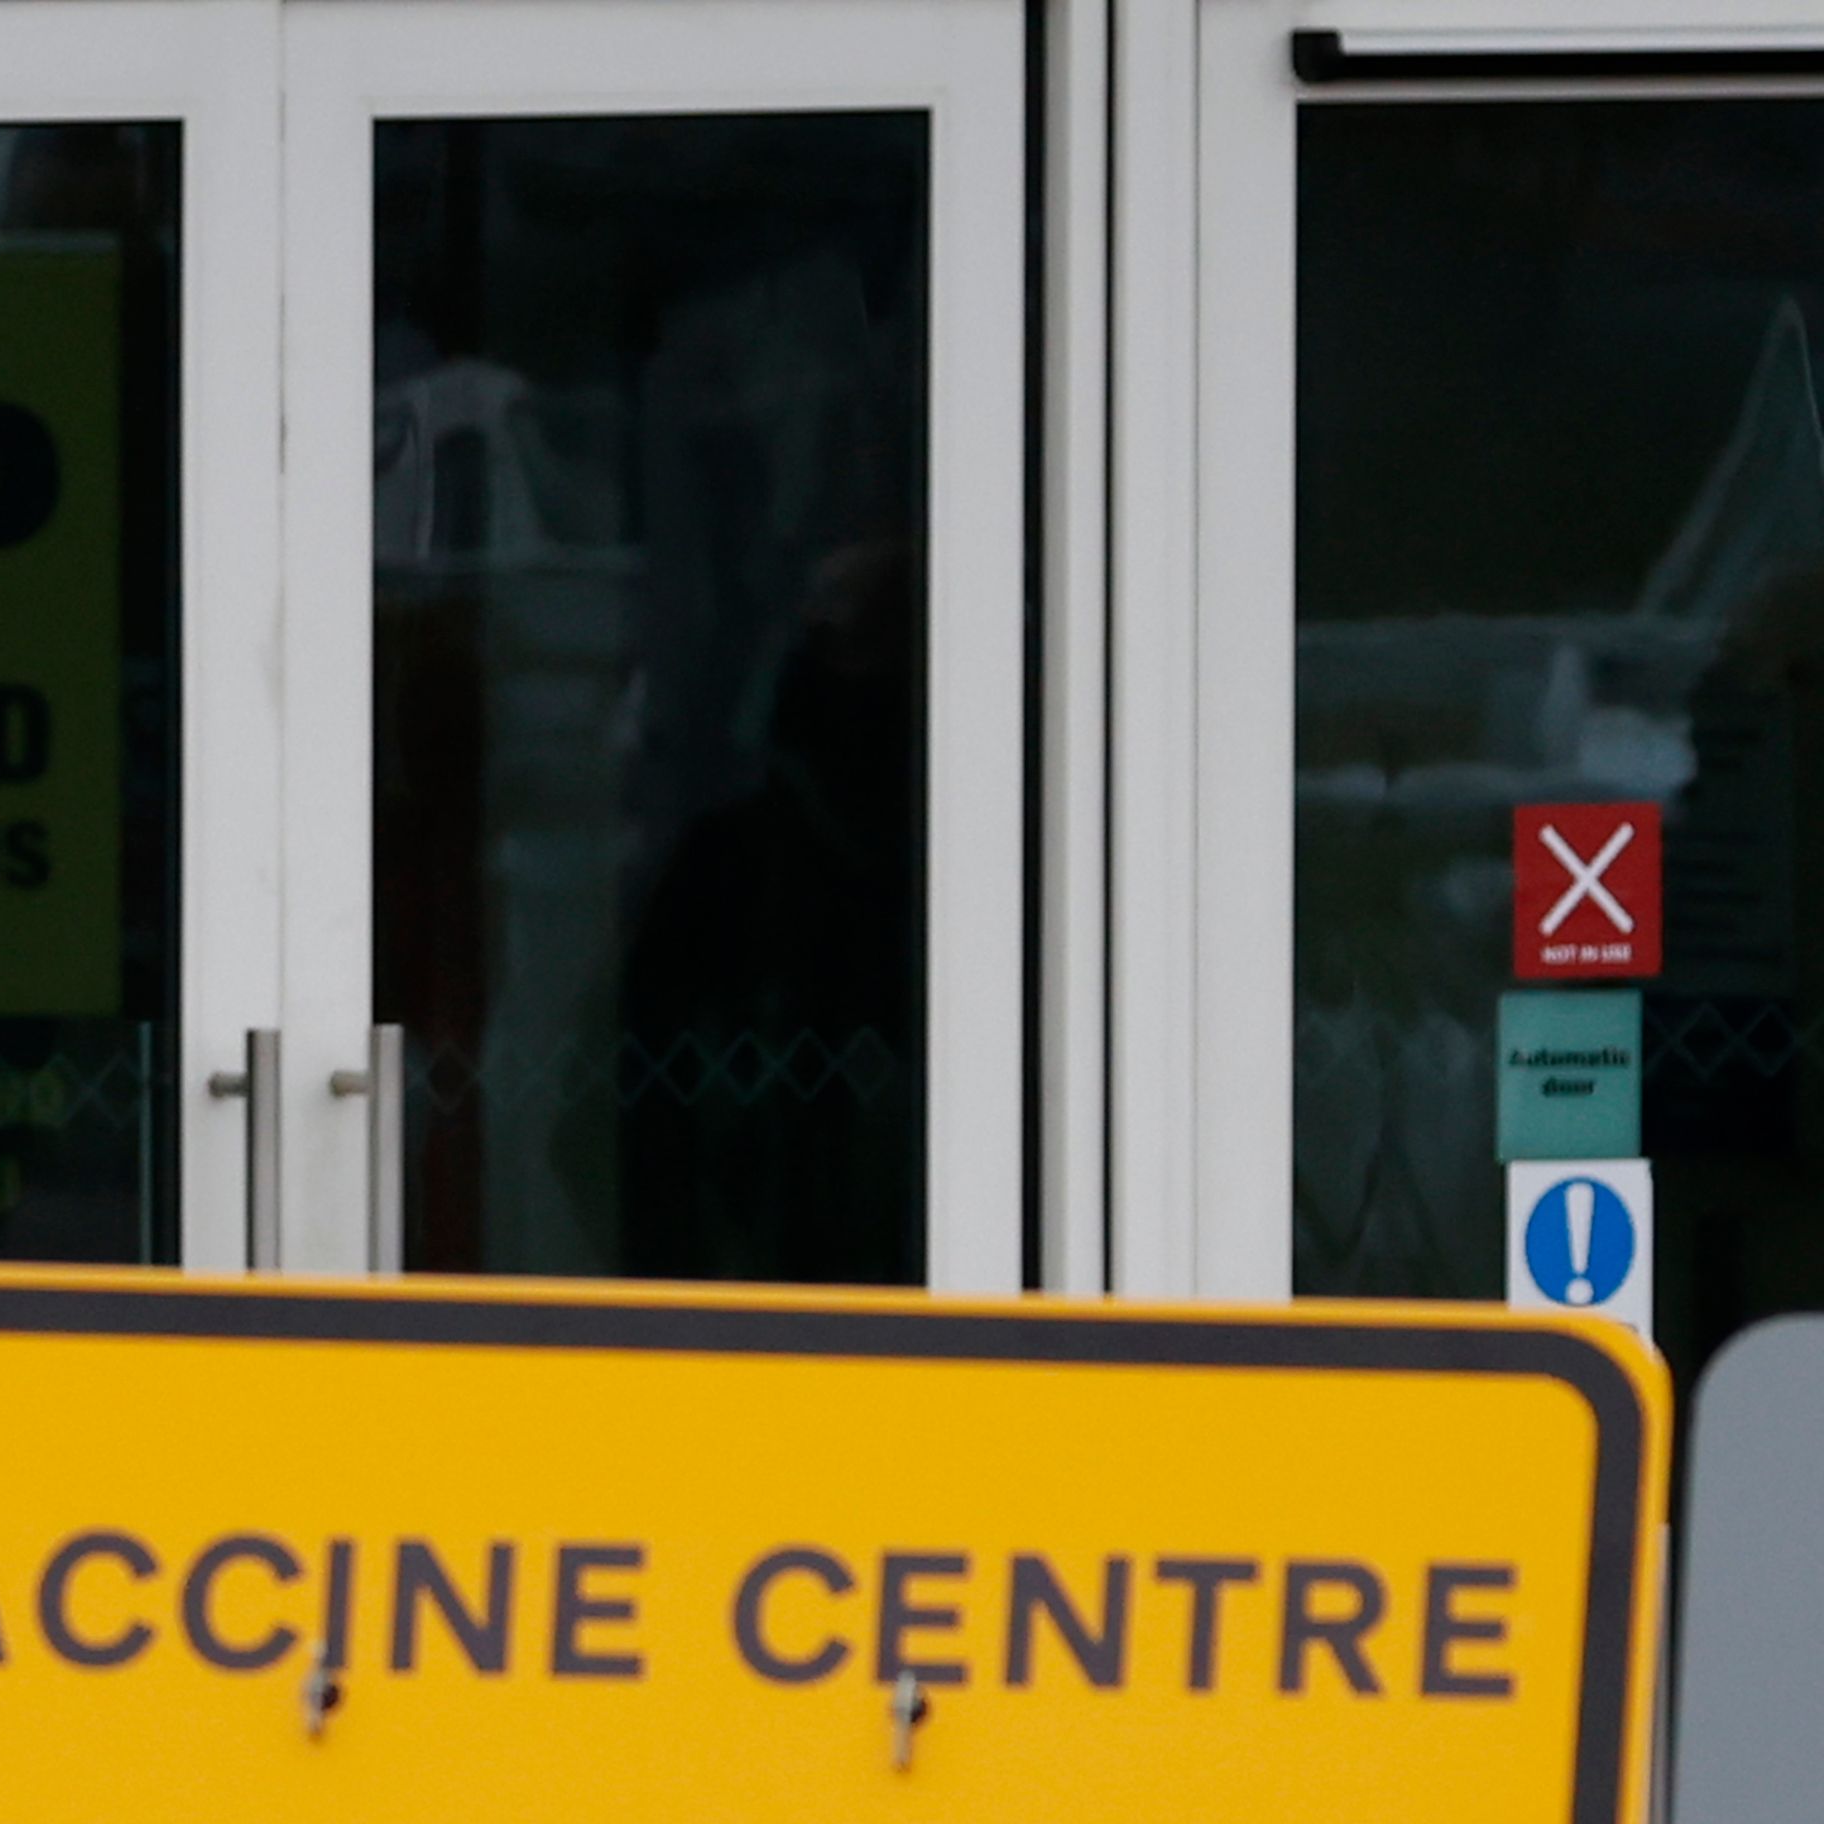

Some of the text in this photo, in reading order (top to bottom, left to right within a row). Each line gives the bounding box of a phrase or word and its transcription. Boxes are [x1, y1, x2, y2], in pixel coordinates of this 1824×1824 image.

[1508, 1045, 1630, 1069] Automatic
[1540, 1076, 1595, 1098] door
[730, 1546, 1519, 1700] CENTRE
